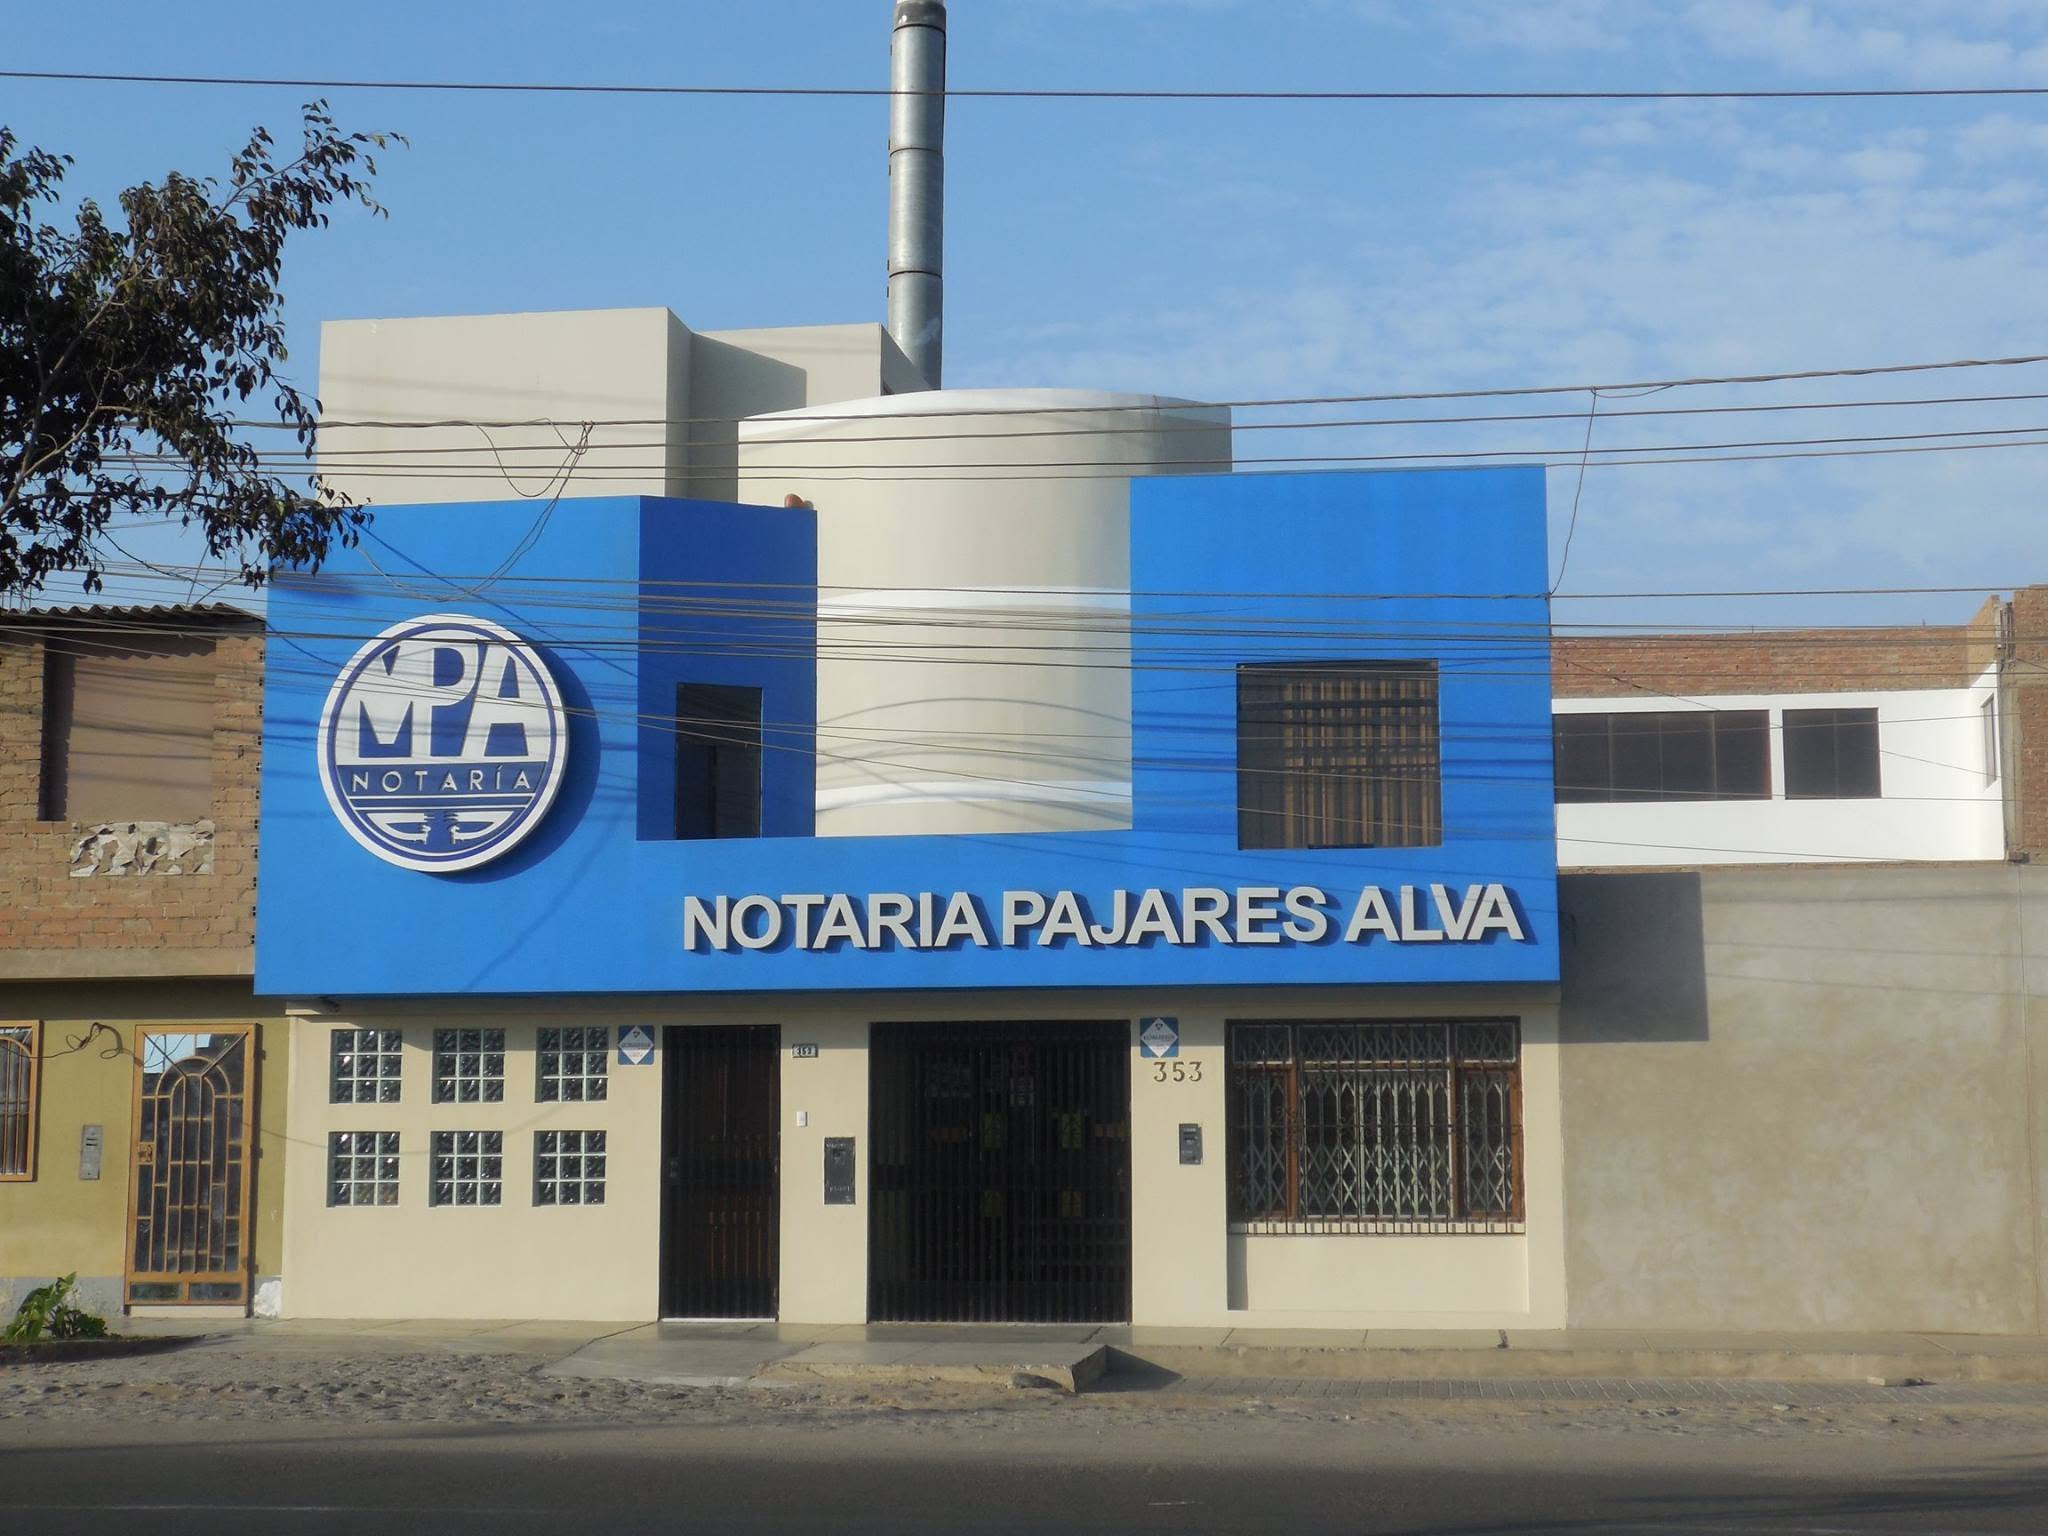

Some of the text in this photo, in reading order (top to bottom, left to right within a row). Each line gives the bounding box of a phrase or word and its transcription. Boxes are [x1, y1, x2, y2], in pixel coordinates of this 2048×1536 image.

[352, 766, 531, 792] NOTARÍA
[683, 884, 1525, 950] NOTARIA PAJARES ALVA
[1153, 1061, 1202, 1082] 353
